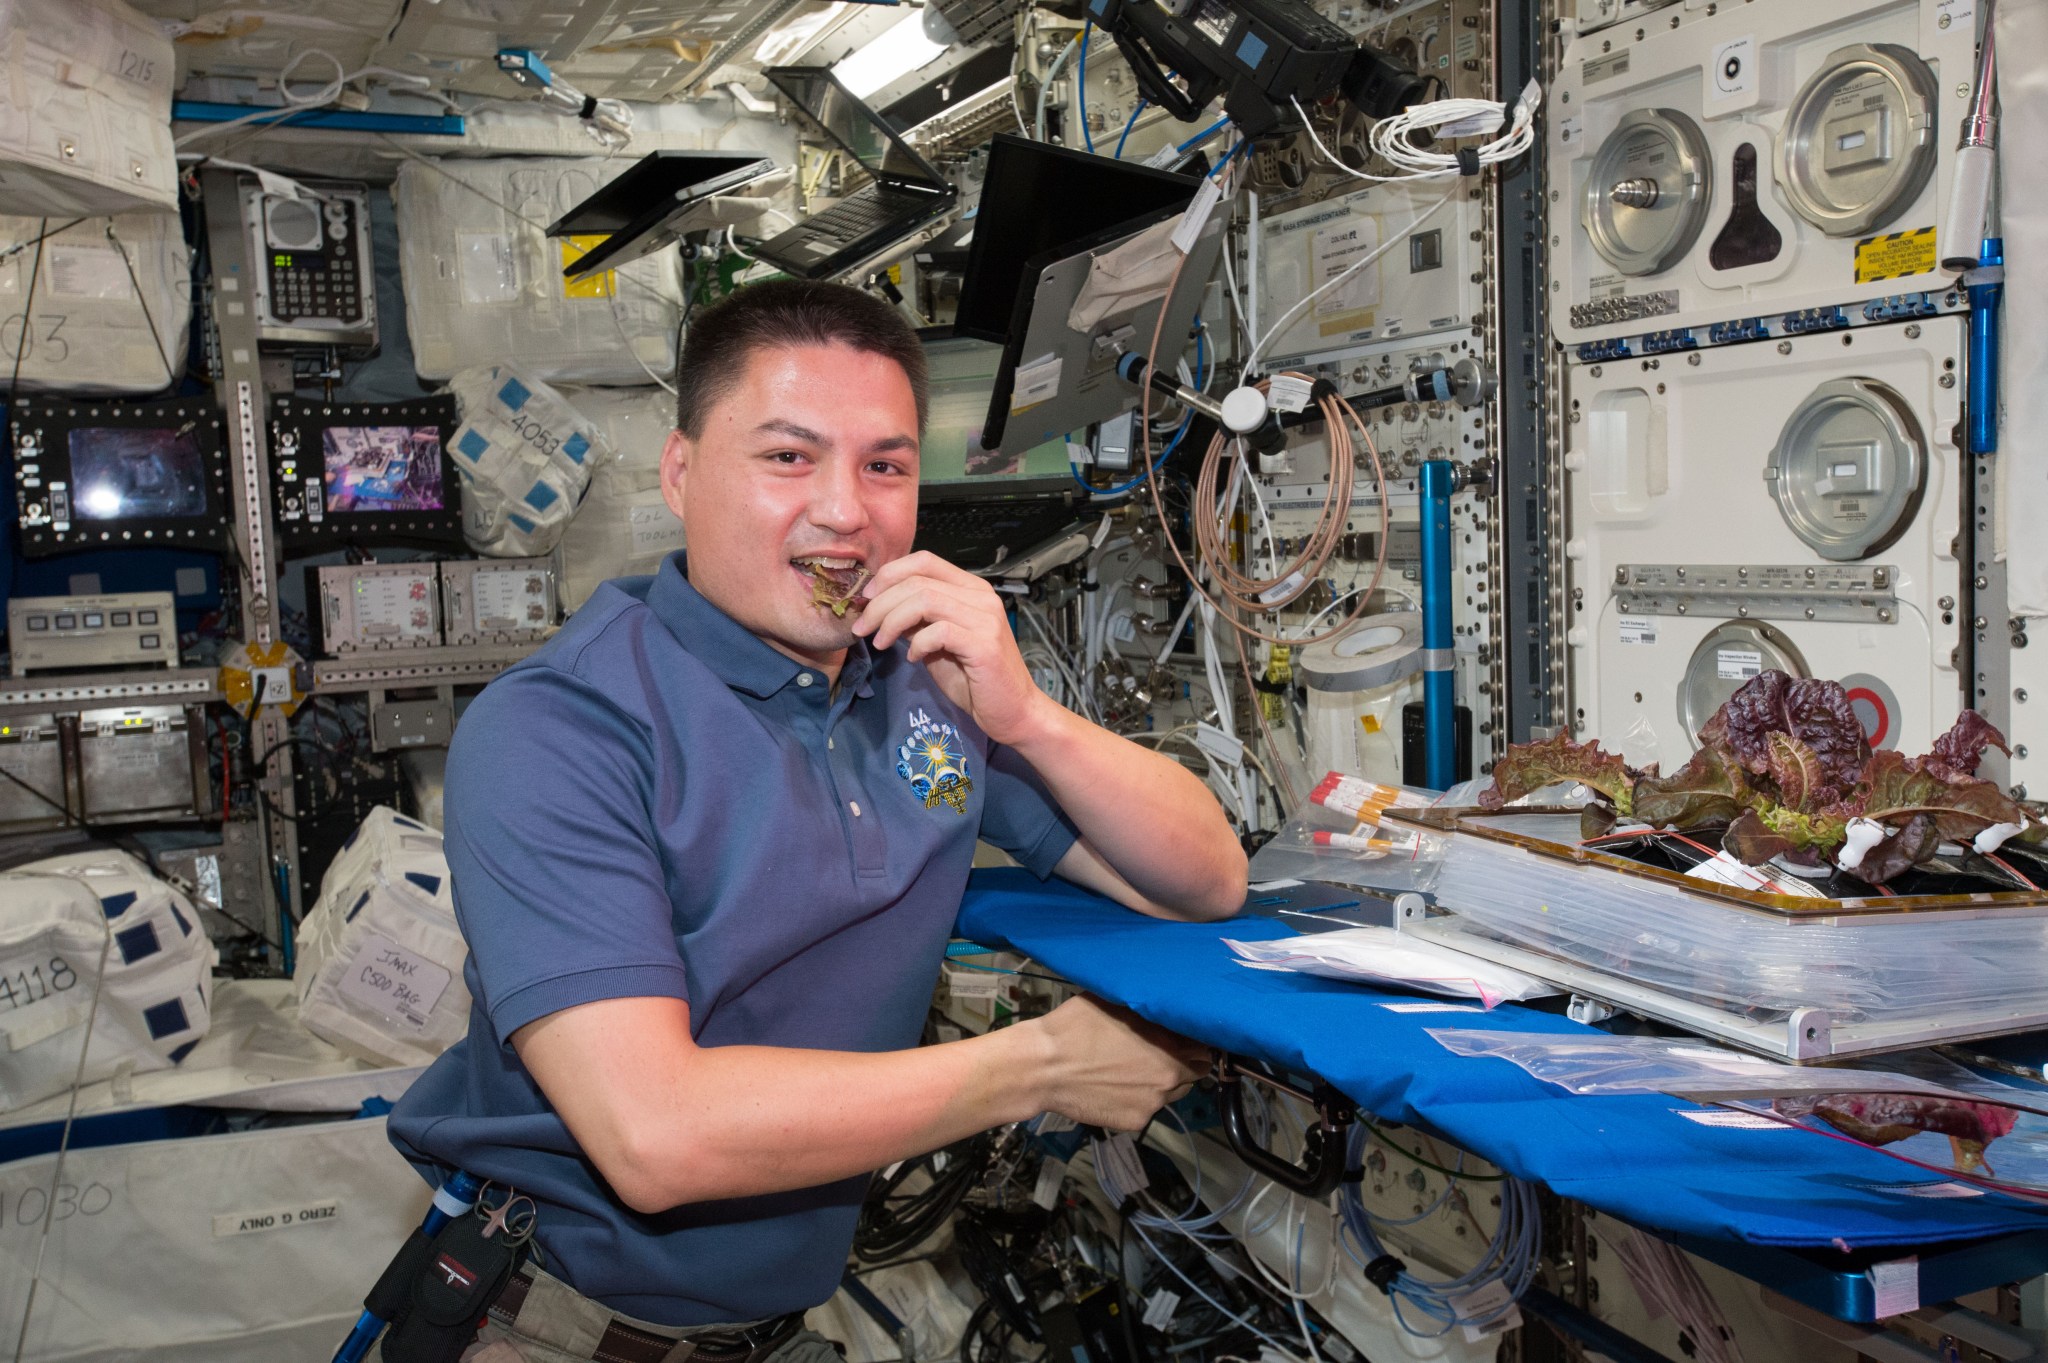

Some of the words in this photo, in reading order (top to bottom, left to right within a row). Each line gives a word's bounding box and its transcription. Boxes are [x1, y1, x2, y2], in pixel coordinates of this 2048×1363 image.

[118, 49, 155, 81] 1215
[1320, 207, 1351, 223] CONTAINER
[1865, 251, 1881, 259] OPEN
[1912, 241, 1936, 250] SEALING
[1887, 238, 1914, 249] CAUTION
[511, 414, 560, 457] 4053
[637, 529, 683, 544] TOOLKI
[908, 707, 932, 730] 44
[1790, 876, 1808, 889] Plant
[1808, 885, 1823, 899] Pillo
[0, 956, 77, 1008] 4118
[392, 982, 421, 1004] BAG
[282, 1212, 293, 1224] G
[299, 1206, 337, 1221] ZERO
[239, 1215, 275, 1231] ONLY
